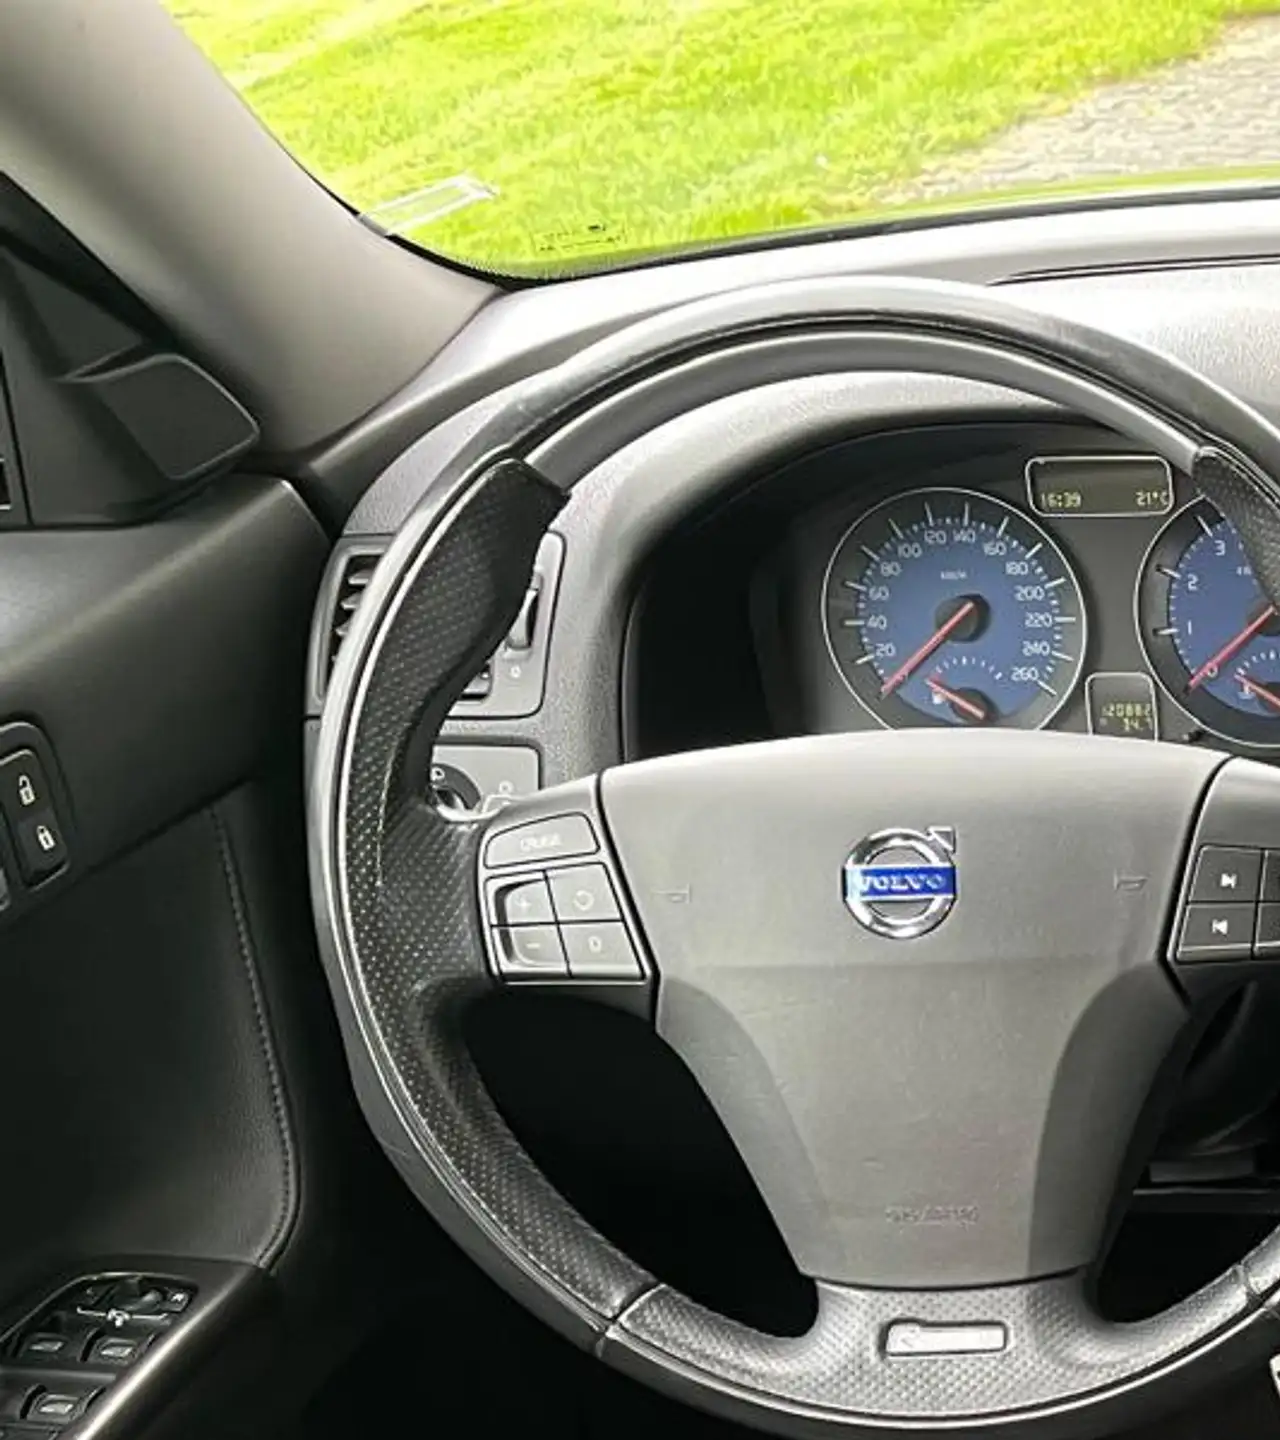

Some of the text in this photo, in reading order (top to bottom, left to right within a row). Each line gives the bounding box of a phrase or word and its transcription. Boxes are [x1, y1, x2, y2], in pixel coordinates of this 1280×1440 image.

[898, 542, 922, 558] 100
[983, 543, 1007, 556] 160
[1213, 539, 1227, 556] 3
[880, 562, 902, 577] 80
[1005, 562, 1029, 575] 180
[1186, 573, 1199, 591] 2
[869, 586, 889, 601] 60
[1014, 584, 1046, 601] 200
[867, 614, 887, 630] 40
[1025, 612, 1053, 628] 220
[875, 642, 896, 657] 20
[1022, 640, 1050, 656] 240
[1010, 666, 1039, 682] 260
[857, 874, 947, 891] VOLVO
